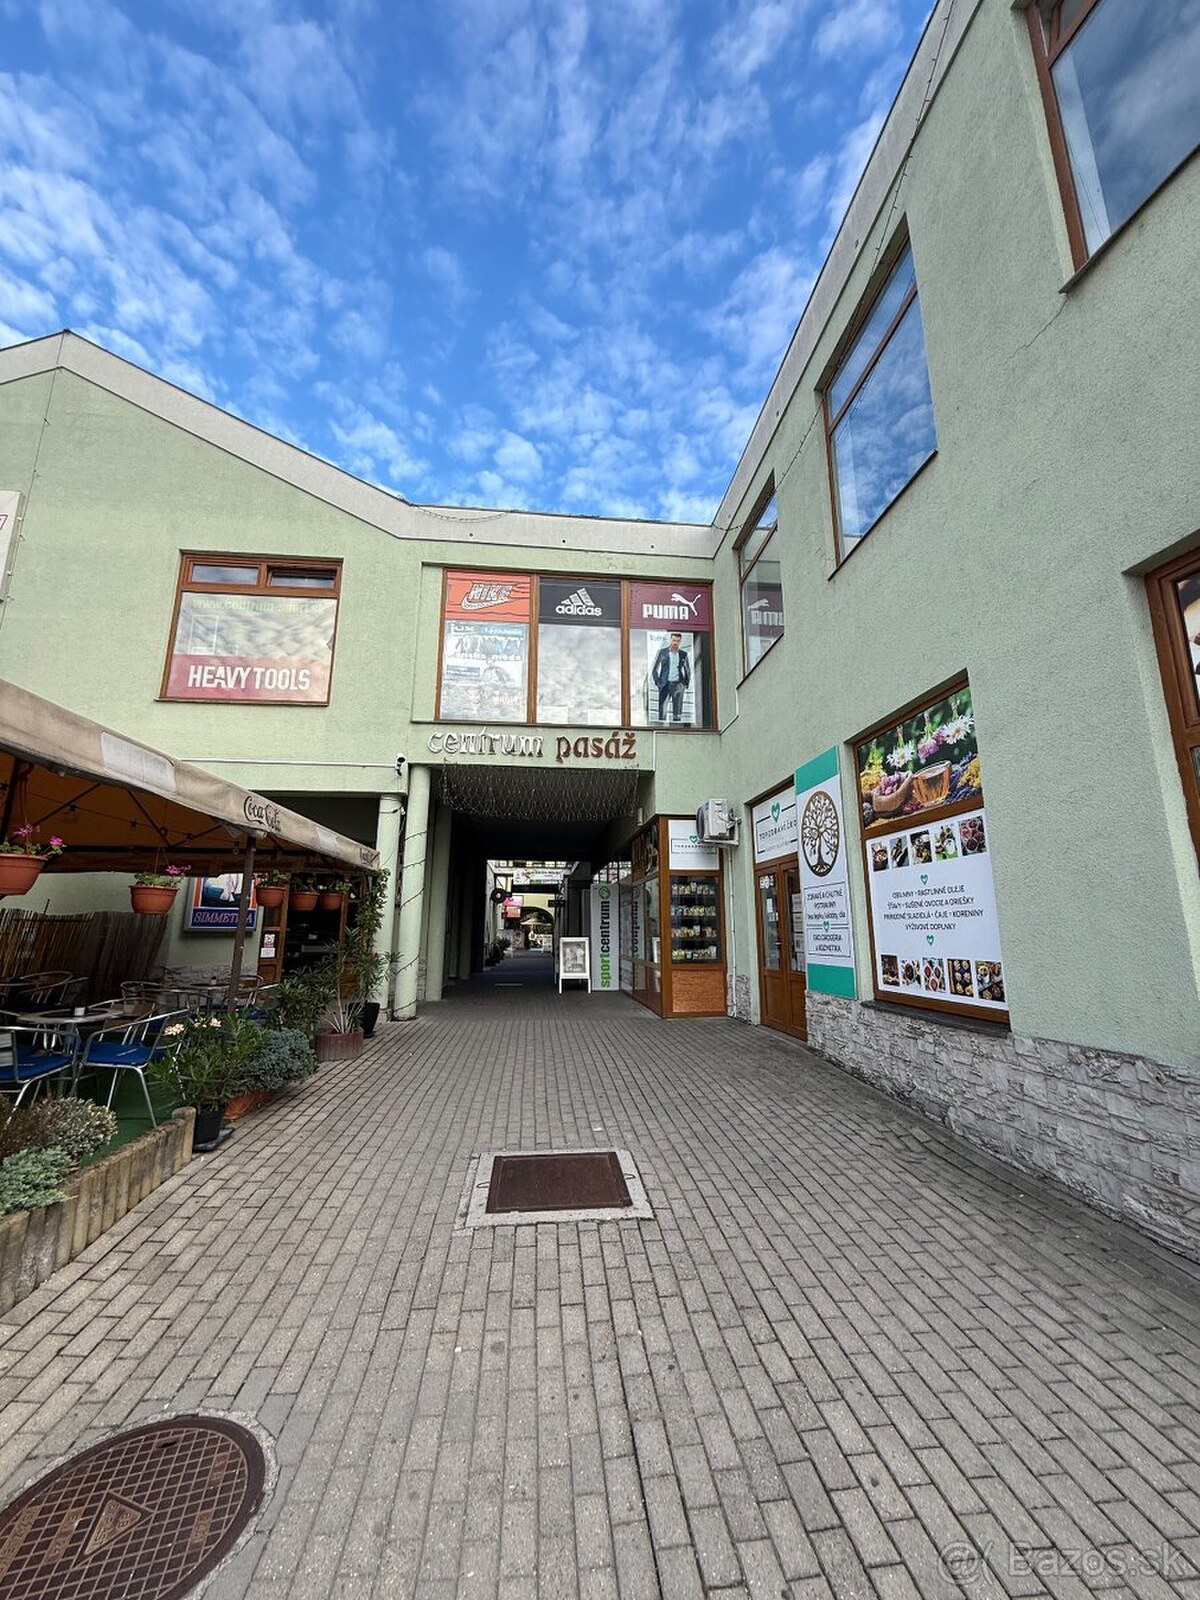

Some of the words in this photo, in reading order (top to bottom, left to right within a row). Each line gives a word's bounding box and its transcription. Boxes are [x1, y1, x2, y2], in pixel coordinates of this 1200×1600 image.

[468, 583, 513, 601] NIKE
[555, 603, 602, 617] adidas
[642, 603, 689, 621] PUMA
[187, 665, 251, 689] HEAVY
[252, 667, 311, 690] TOOLS
[428, 727, 544, 758] centrum
[556, 731, 637, 763] pasáž
[193, 911, 253, 924] SIMMETA
[600, 900, 612, 988] sportcentrum
